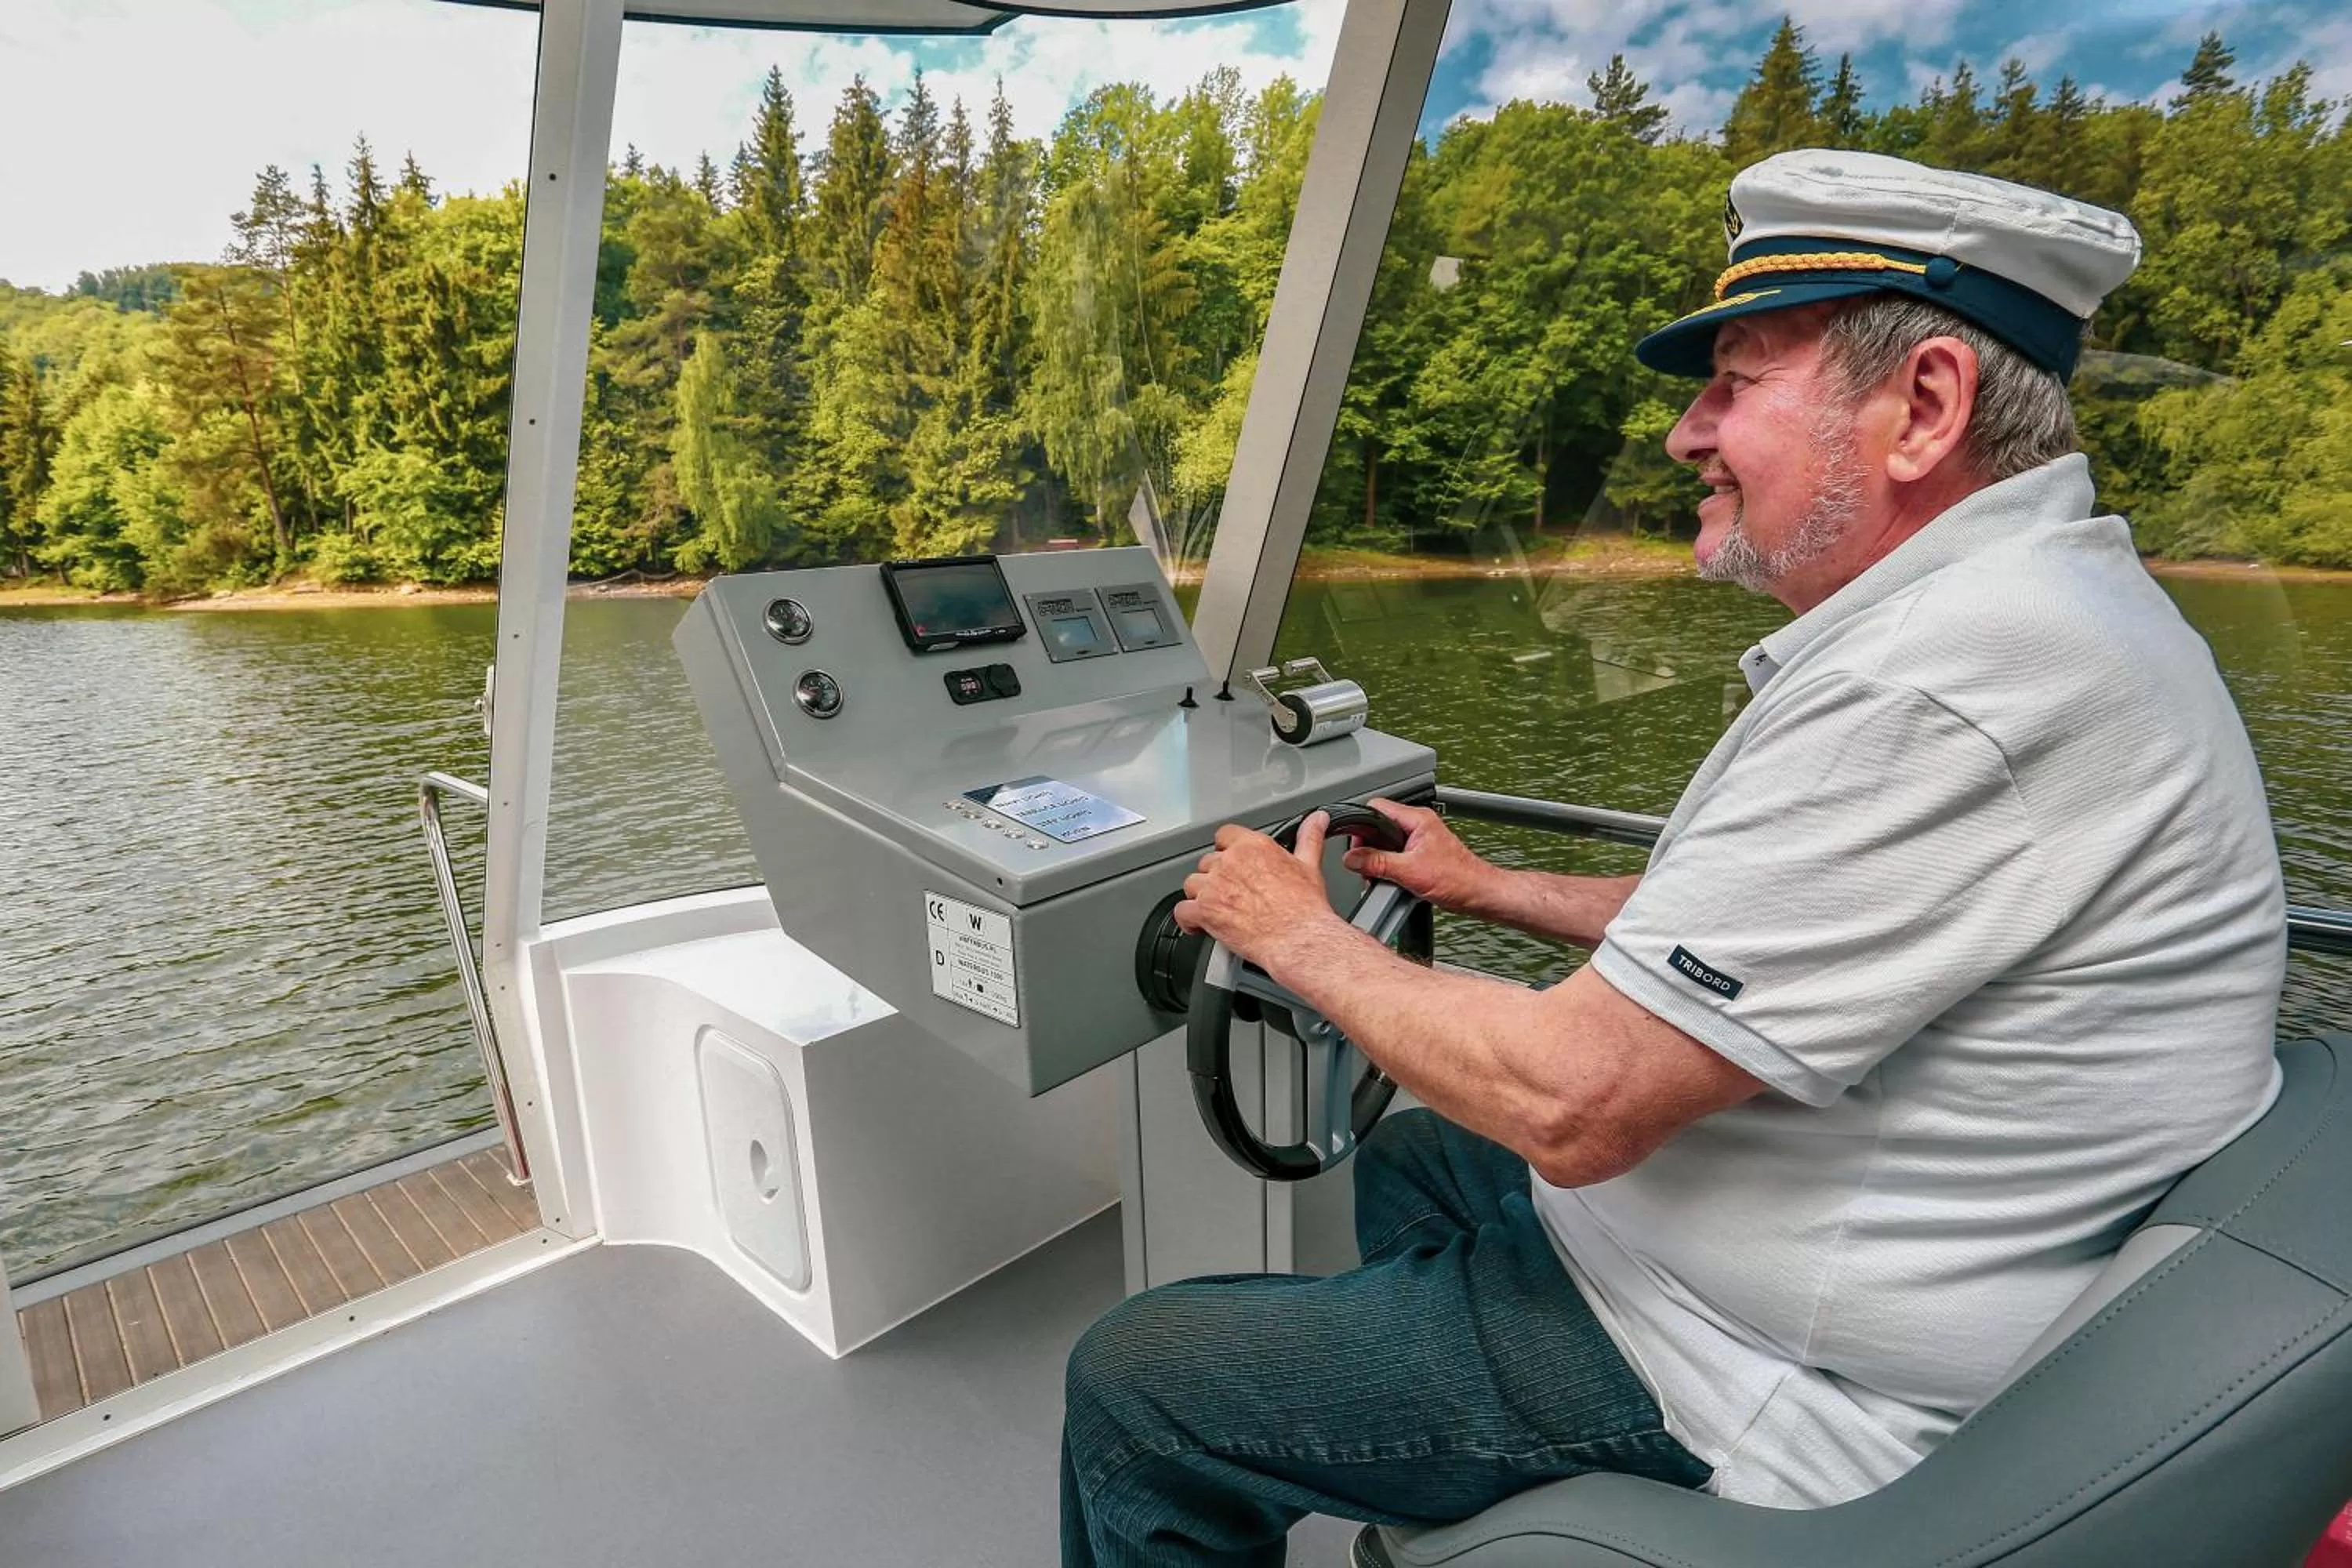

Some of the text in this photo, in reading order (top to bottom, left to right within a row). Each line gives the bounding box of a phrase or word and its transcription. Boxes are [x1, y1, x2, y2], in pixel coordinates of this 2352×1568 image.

[929, 901, 945, 922] CE
[969, 913, 982, 931] W
[935, 949, 945, 966] D
[1679, 954, 1731, 991] TRIBORD
